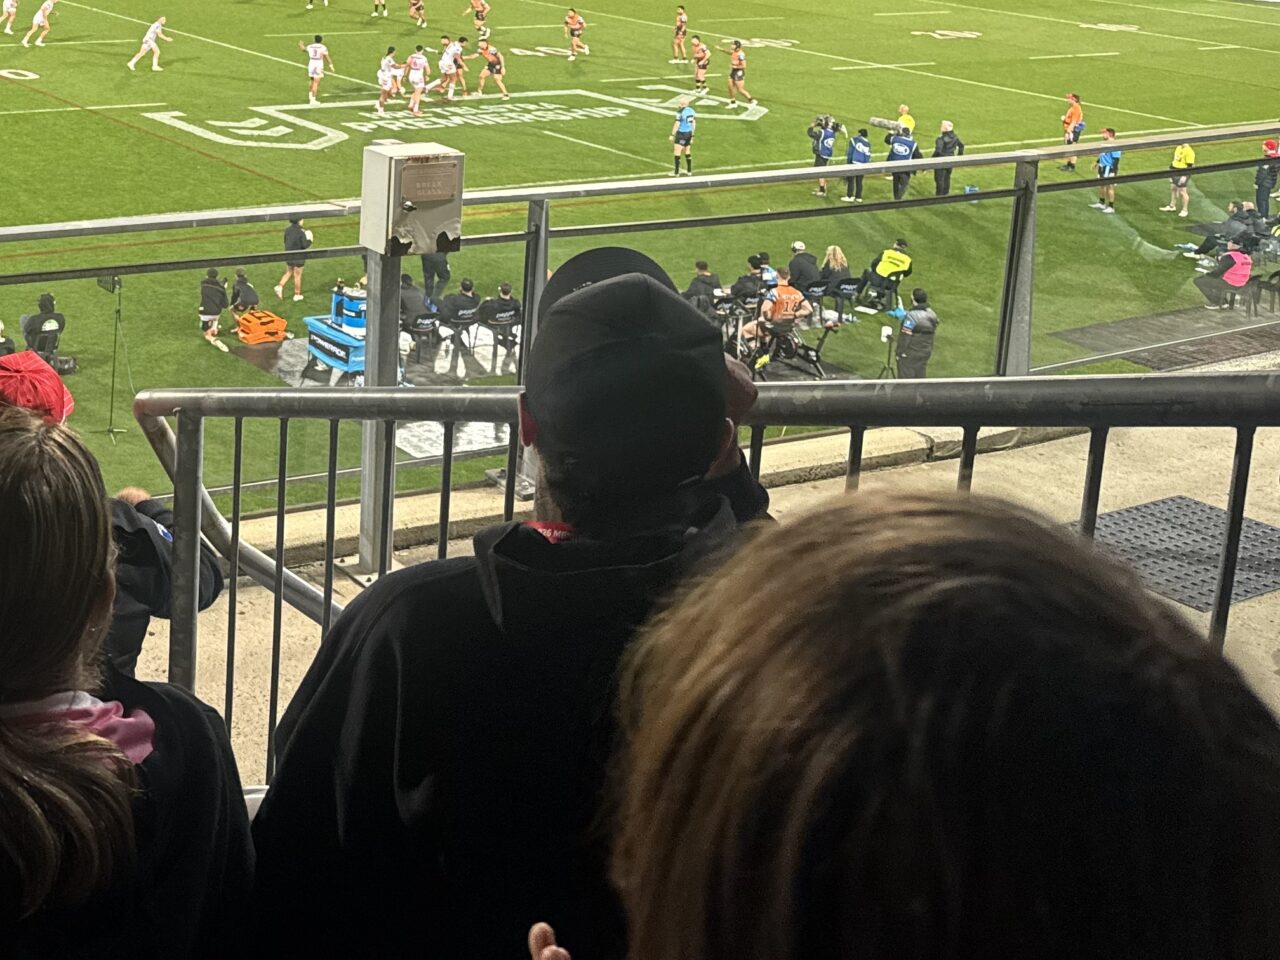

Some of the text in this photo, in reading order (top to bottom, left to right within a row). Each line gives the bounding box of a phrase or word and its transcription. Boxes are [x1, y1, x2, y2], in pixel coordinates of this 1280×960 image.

[422, 102, 569, 116] TELSTRA
[341, 106, 630, 132] PREMIERSHIP
[784, 302, 799, 312] 16
